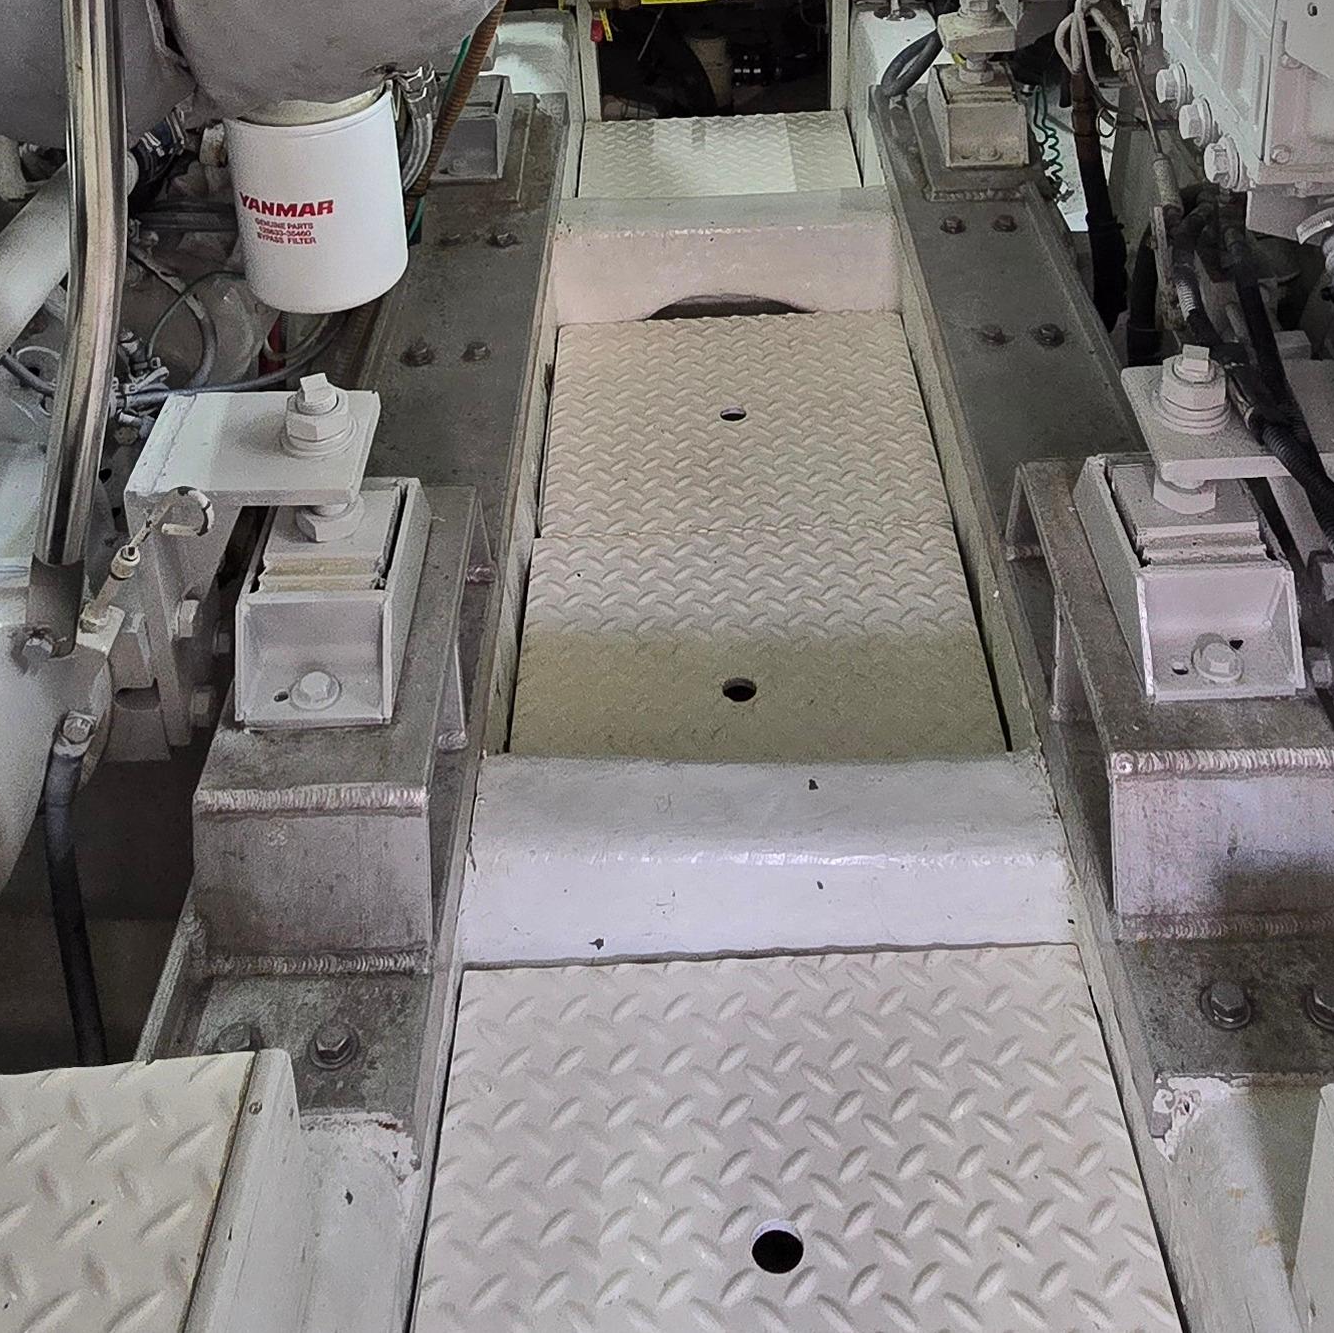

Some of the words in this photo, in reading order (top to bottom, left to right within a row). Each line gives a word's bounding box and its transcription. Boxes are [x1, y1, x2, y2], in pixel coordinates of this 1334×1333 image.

[239, 191, 334, 217] YANMAR
[255, 217, 286, 229] GENUINE
[287, 222, 314, 230] PARTS
[256, 232, 284, 244] BYPASS
[288, 237, 316, 245] FILTER
